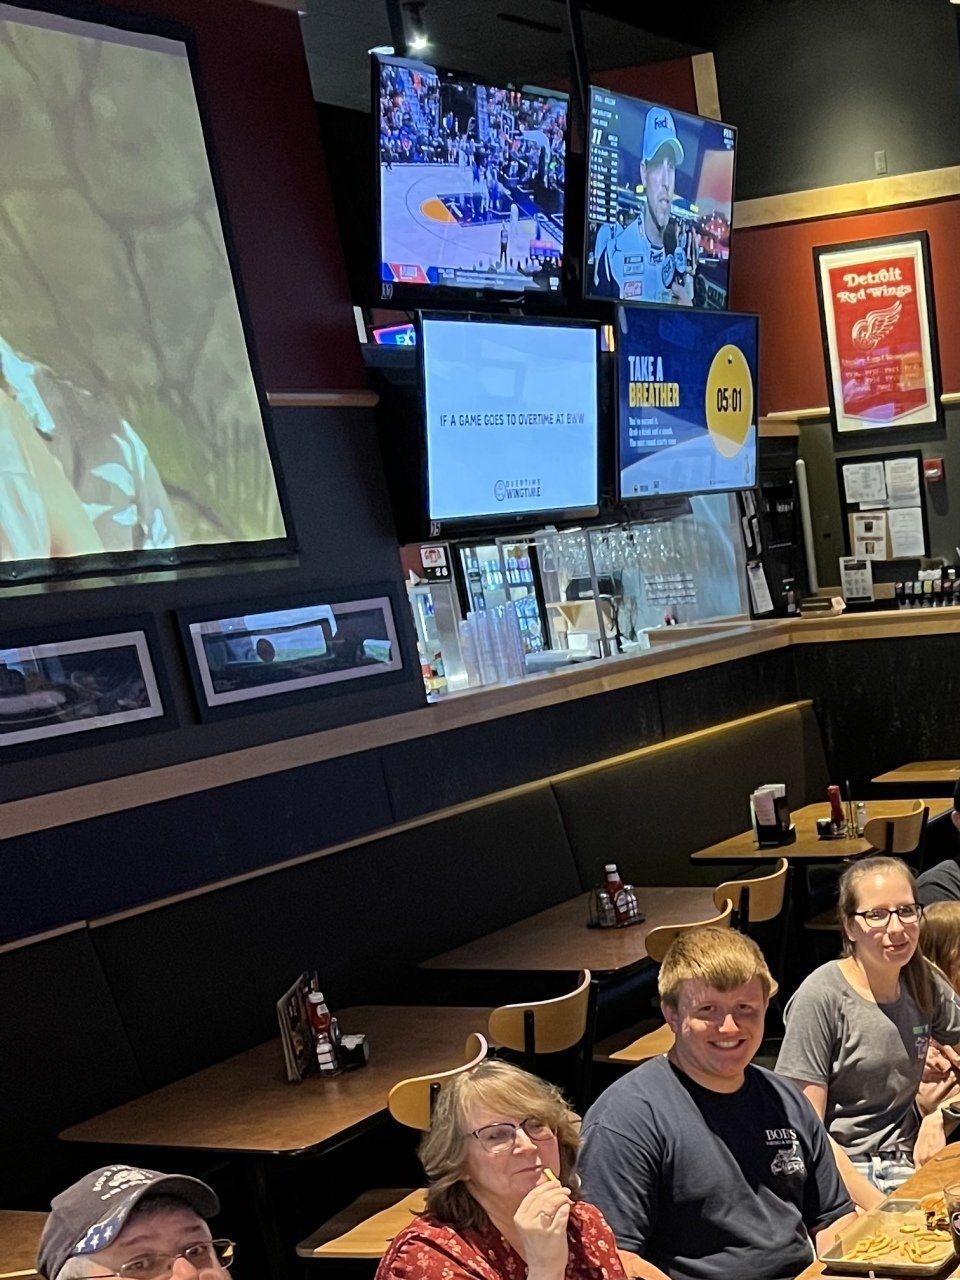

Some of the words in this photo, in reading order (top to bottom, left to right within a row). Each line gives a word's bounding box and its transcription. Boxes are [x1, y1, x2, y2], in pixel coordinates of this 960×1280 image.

[843, 267, 902, 288] Detroit
[836, 289, 866, 303] Red
[866, 284, 912, 298] Wings
[628, 356, 654, 381] TAKE
[656, 356, 663, 381] A
[629, 382, 679, 407] BREATHER
[717, 387, 742, 412] 05:01
[440, 415, 447, 427] IF
[451, 415, 456, 427] A
[459, 414, 482, 426] GAME
[484, 414, 504, 426] GOES
[507, 414, 516, 426] TO
[518, 413, 553, 425] OVERTIME
[555, 413, 564, 425] AT
